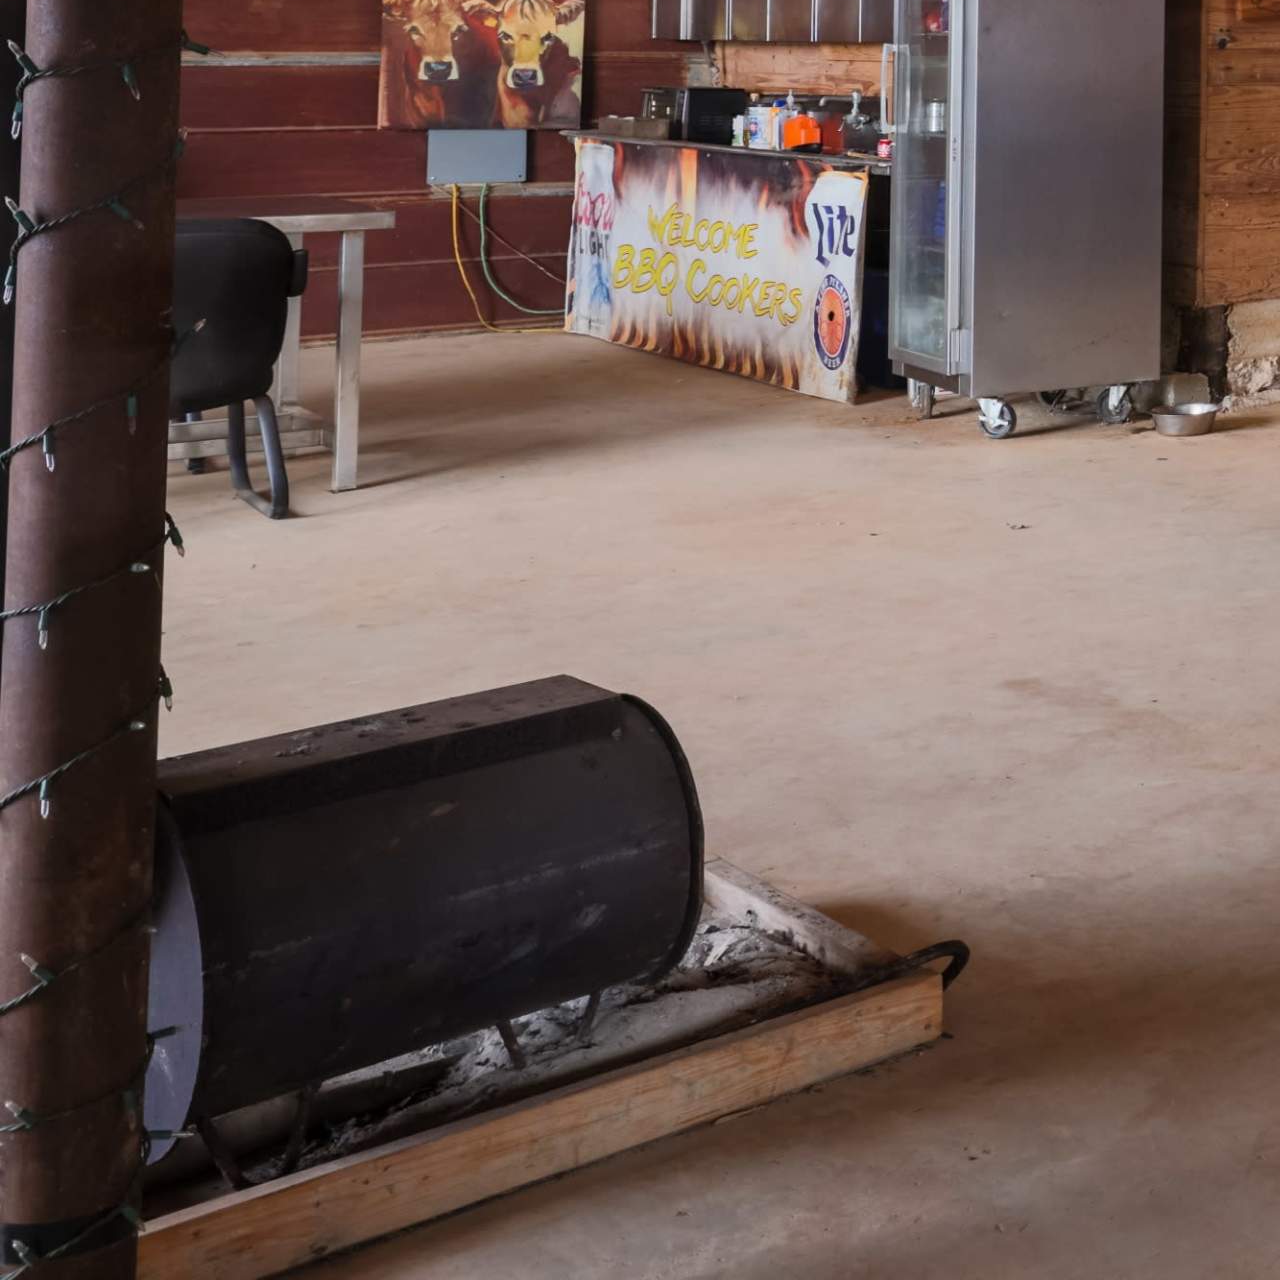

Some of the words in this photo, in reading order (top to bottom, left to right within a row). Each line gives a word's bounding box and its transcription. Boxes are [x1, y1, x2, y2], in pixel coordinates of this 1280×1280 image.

[648, 202, 759, 260] WELCOME
[811, 203, 855, 269] Lite
[613, 244, 679, 317] BBQ
